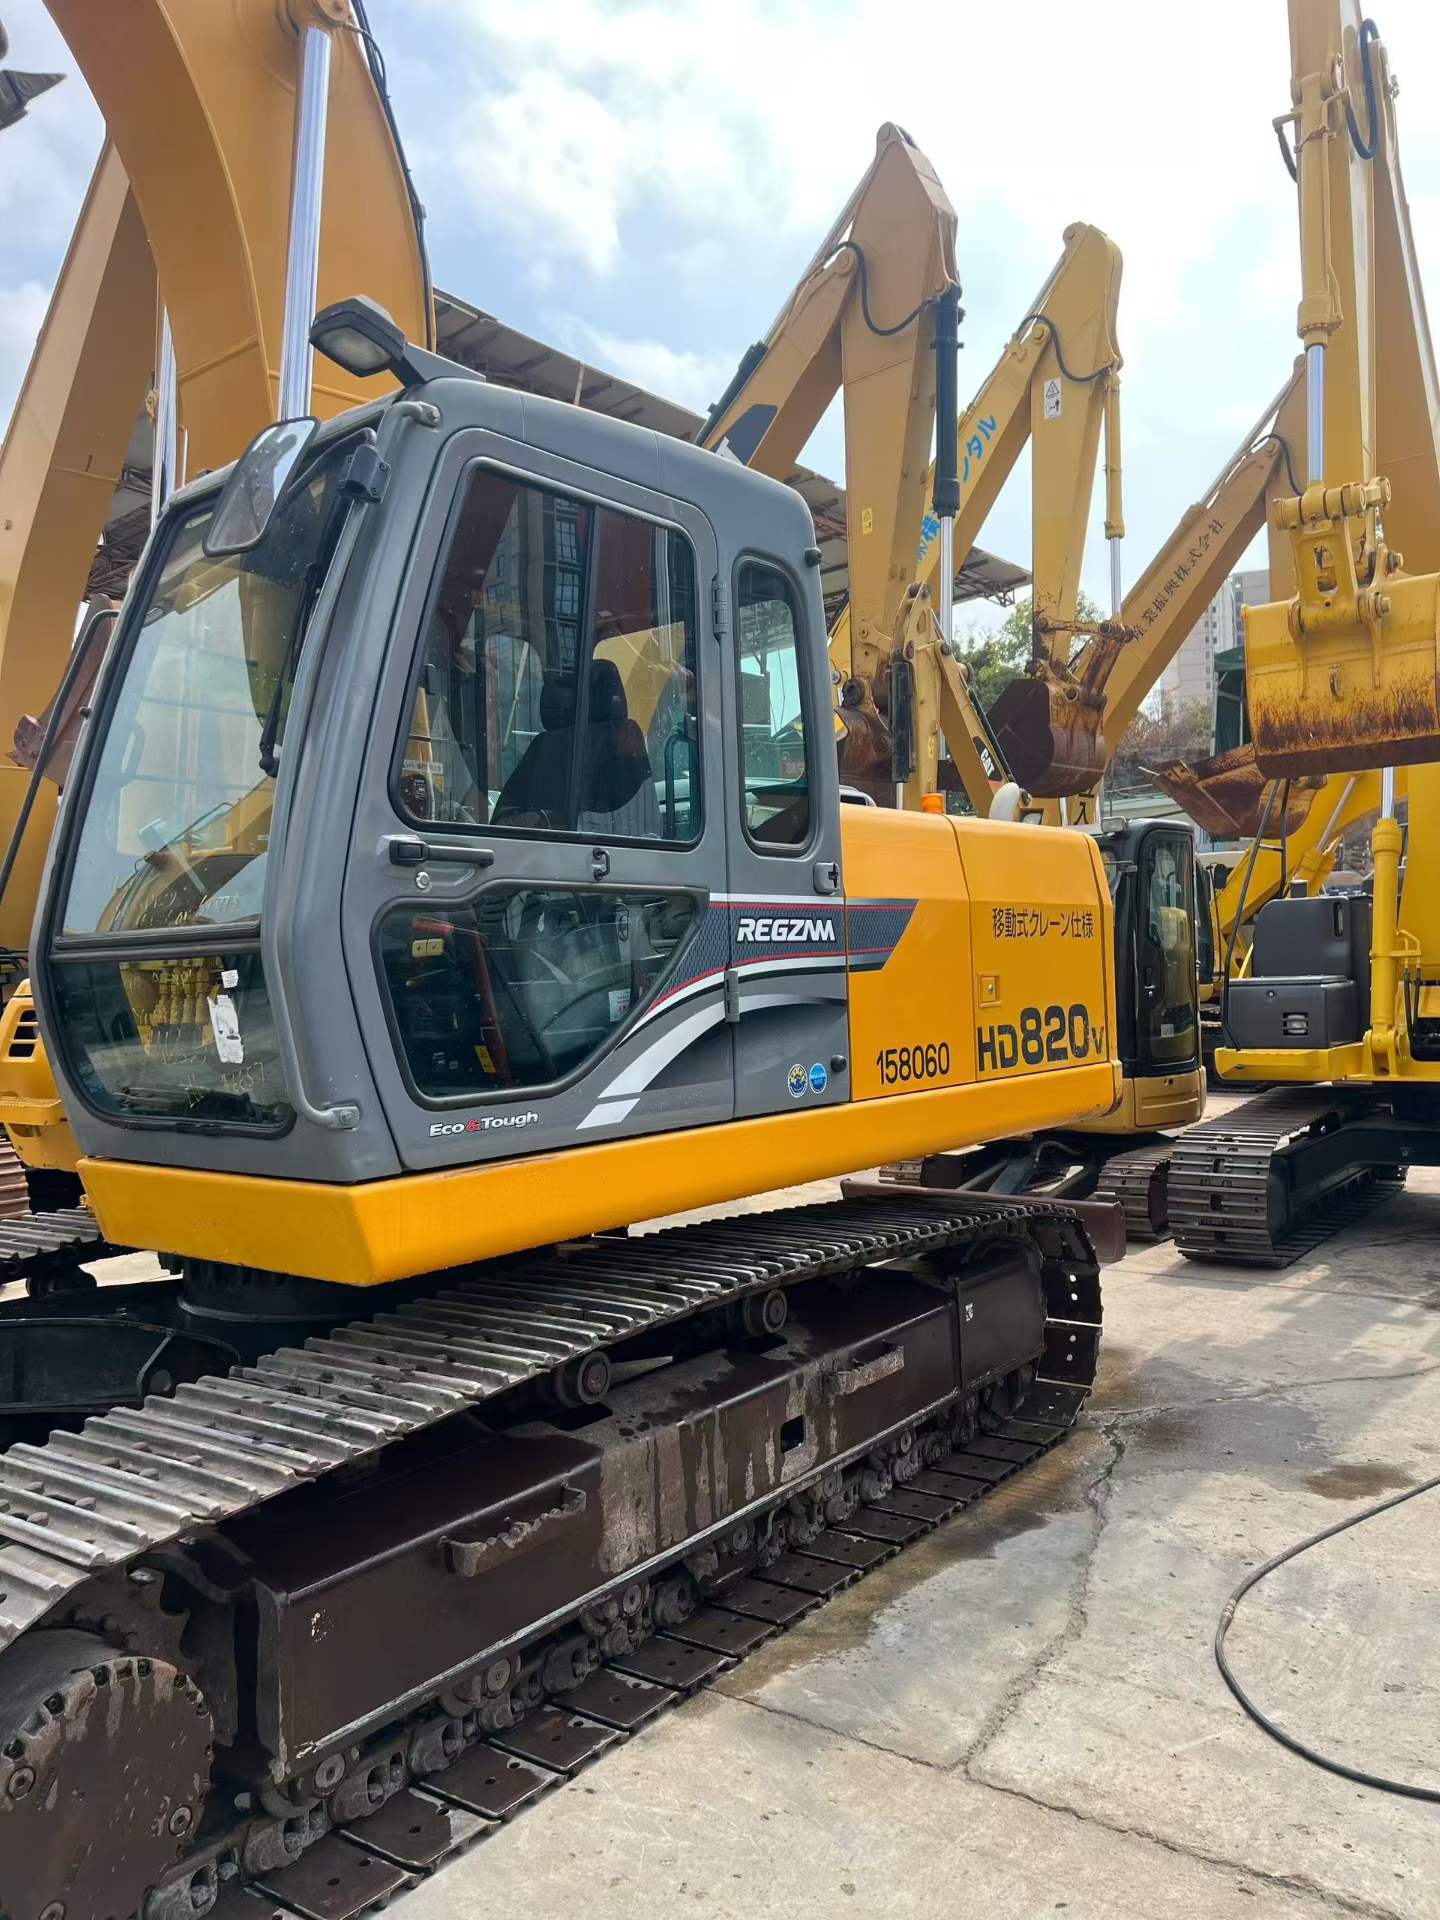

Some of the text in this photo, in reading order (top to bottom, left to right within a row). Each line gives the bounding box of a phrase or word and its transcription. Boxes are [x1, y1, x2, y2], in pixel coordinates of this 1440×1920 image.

[980, 748, 995, 778] CAT
[736, 917, 836, 943] REGZAM
[992, 907, 1094, 939] 移動式クレーン仕様
[876, 1041, 951, 1085] 158060
